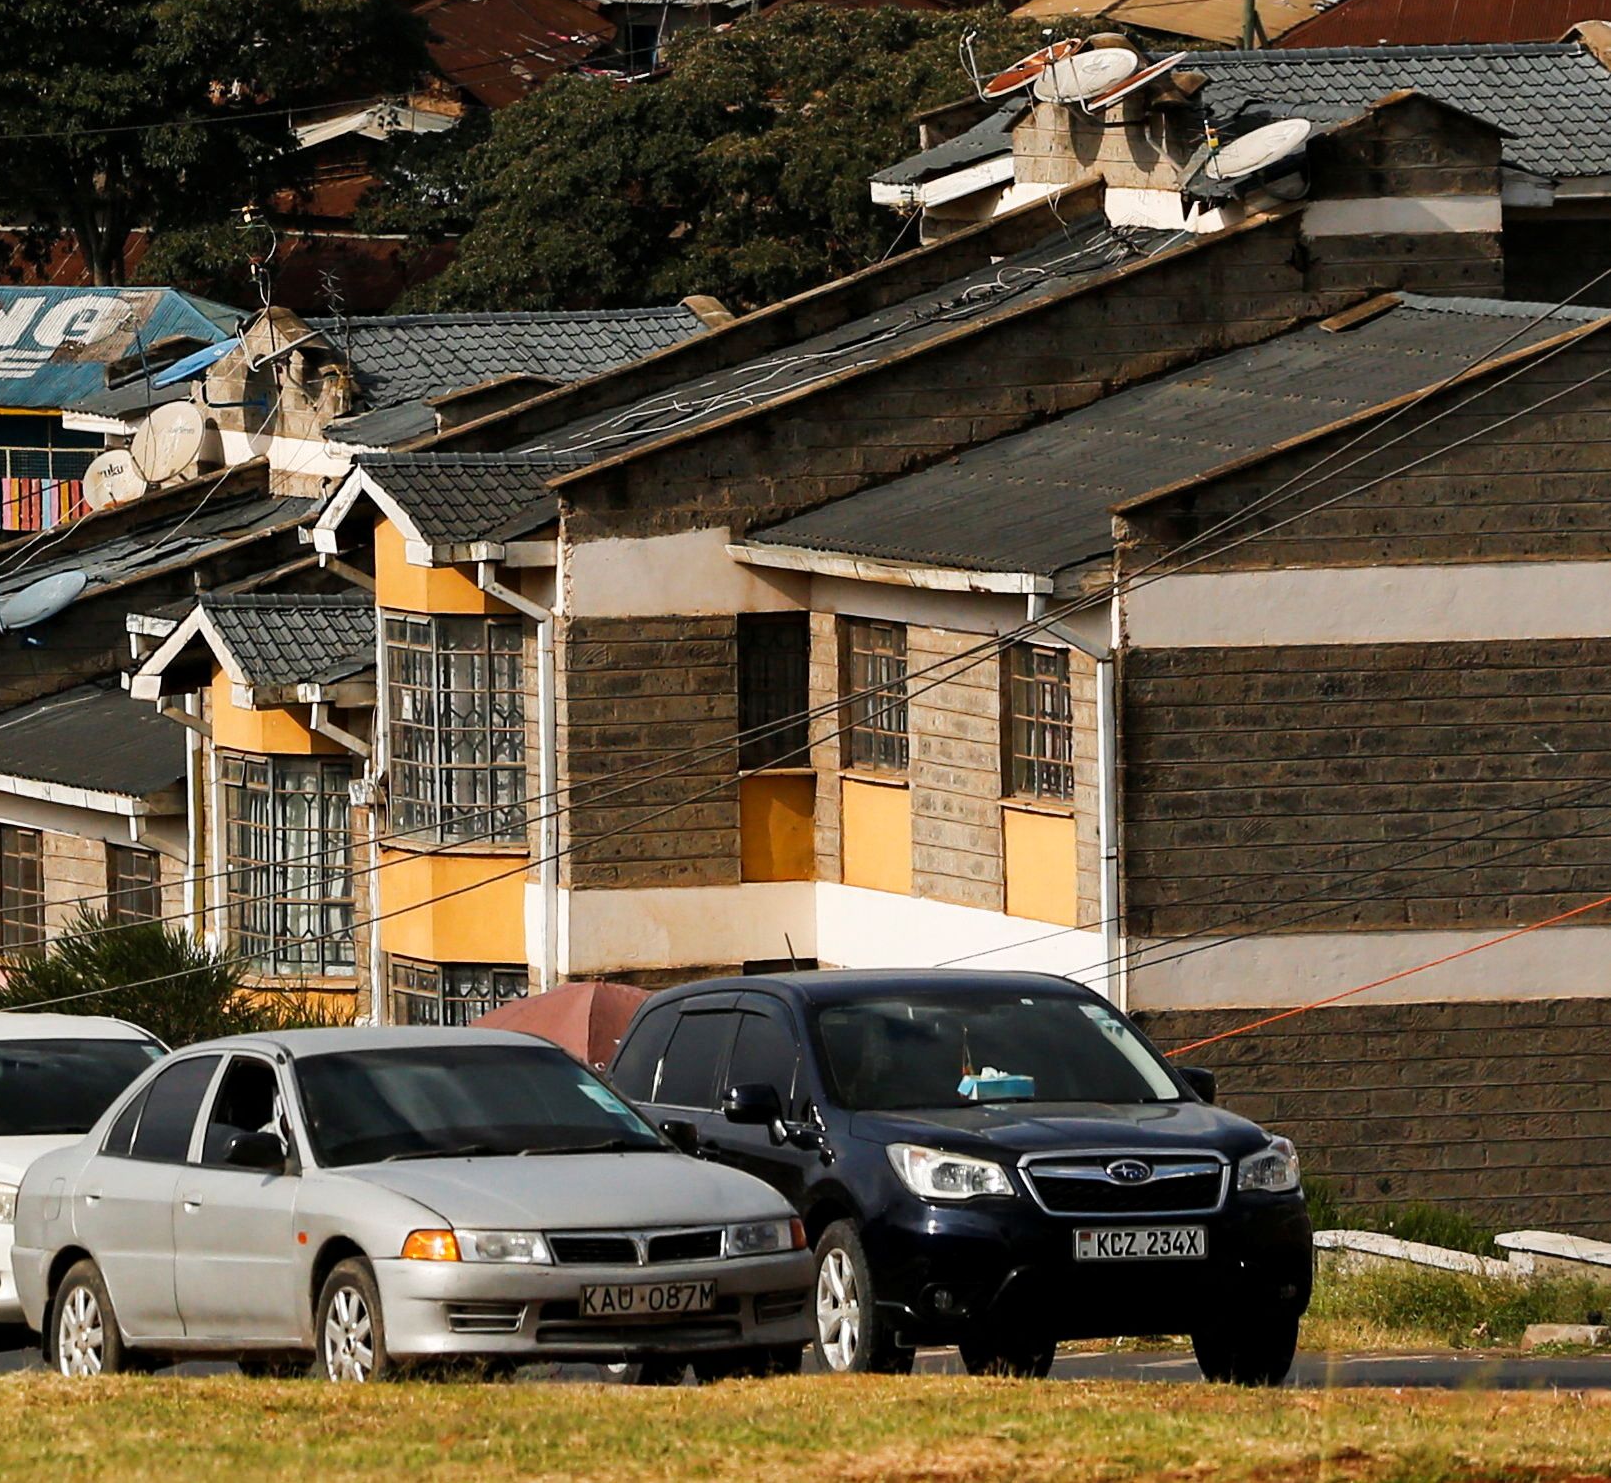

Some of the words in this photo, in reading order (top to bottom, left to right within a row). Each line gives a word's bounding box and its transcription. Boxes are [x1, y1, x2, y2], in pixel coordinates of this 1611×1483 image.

[1097, 1232, 1138, 1256] KCZ
[1147, 1230, 1199, 1256] 234X
[583, 1286, 634, 1313] KAU
[648, 1282, 714, 1312] 087M
